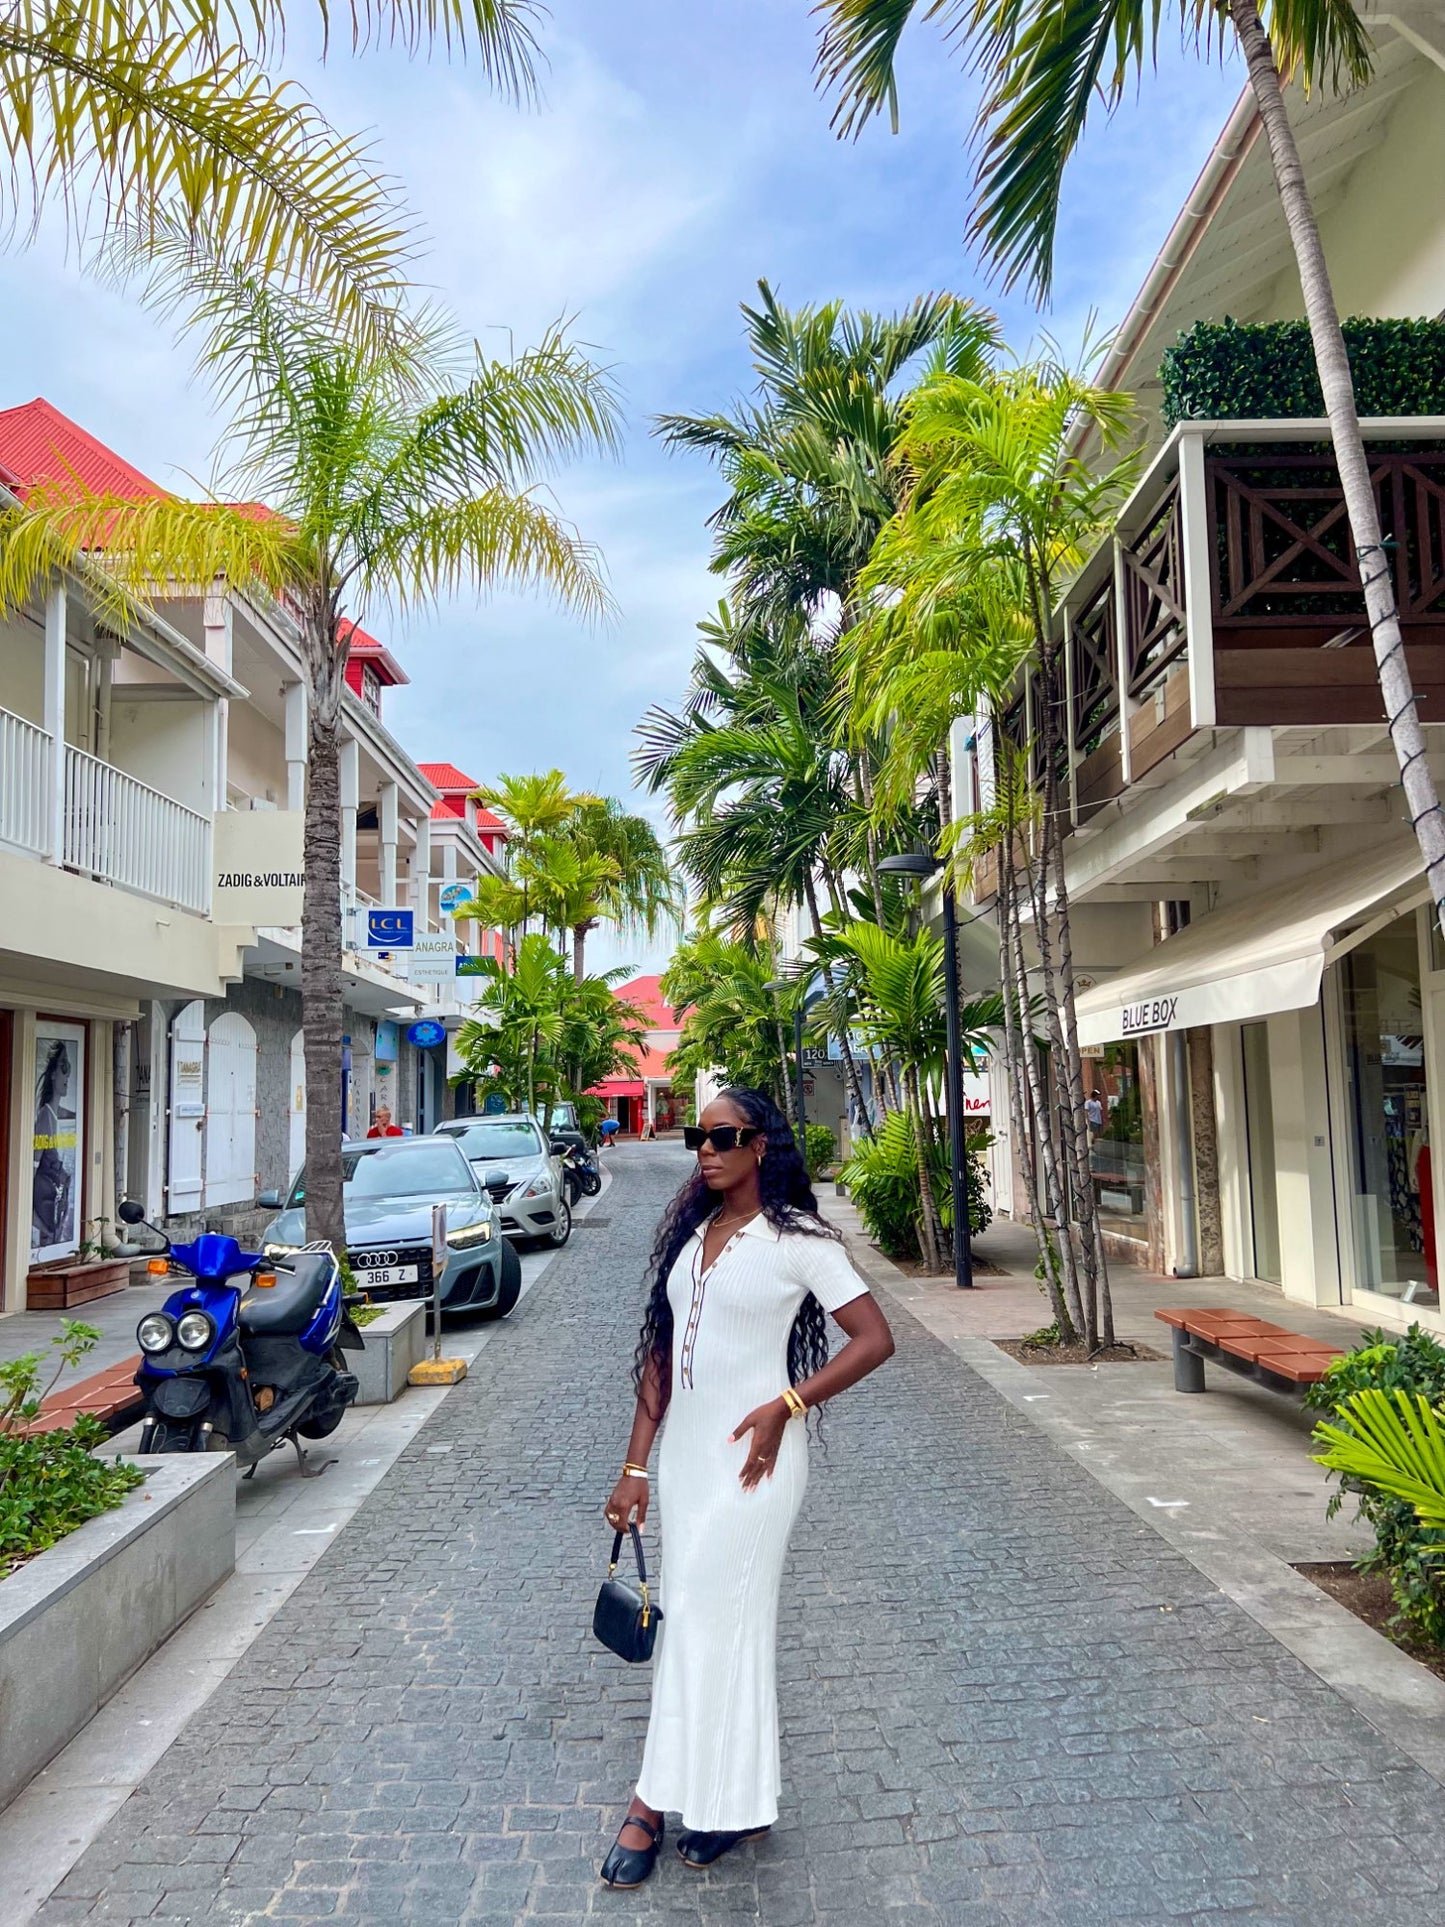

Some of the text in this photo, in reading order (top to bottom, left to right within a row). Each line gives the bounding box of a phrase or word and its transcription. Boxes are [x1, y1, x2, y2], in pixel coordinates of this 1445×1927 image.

[217, 873, 306, 887] ZADIG&VOLTAIR
[371, 918, 408, 930] LCL
[414, 941, 454, 953] ANAGRA
[1122, 997, 1178, 1030] BLUE BOX
[806, 1048, 826, 1060] 120
[1081, 1046, 1100, 1055] PEN
[367, 1269, 406, 1284] 366 Z
